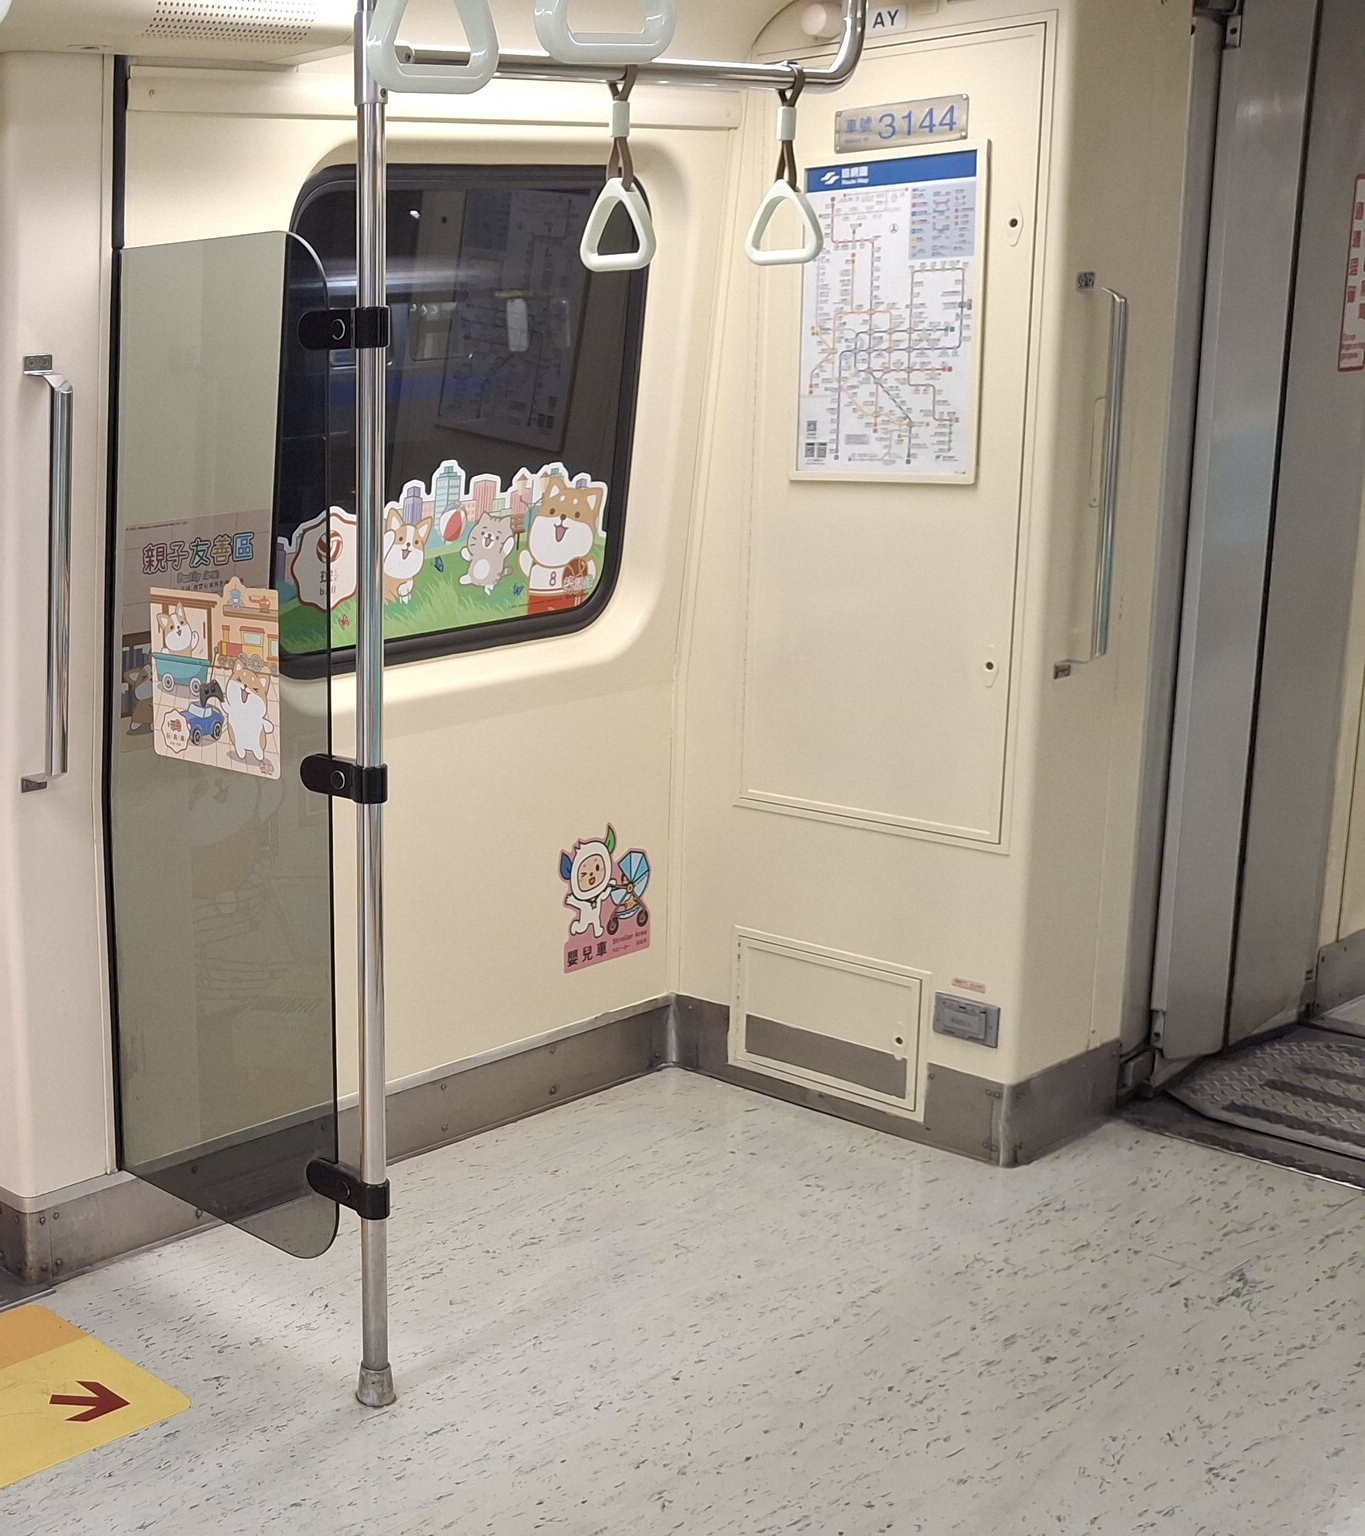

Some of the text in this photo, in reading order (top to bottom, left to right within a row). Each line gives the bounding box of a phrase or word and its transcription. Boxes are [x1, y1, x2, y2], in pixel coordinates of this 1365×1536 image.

[873, 9, 899, 29] AY
[878, 104, 957, 140] 3144
[142, 531, 255, 574] 親子友善區
[549, 570, 557, 587] 8
[319, 585, 336, 596] bll
[567, 941, 608, 967] 嬰兒車
